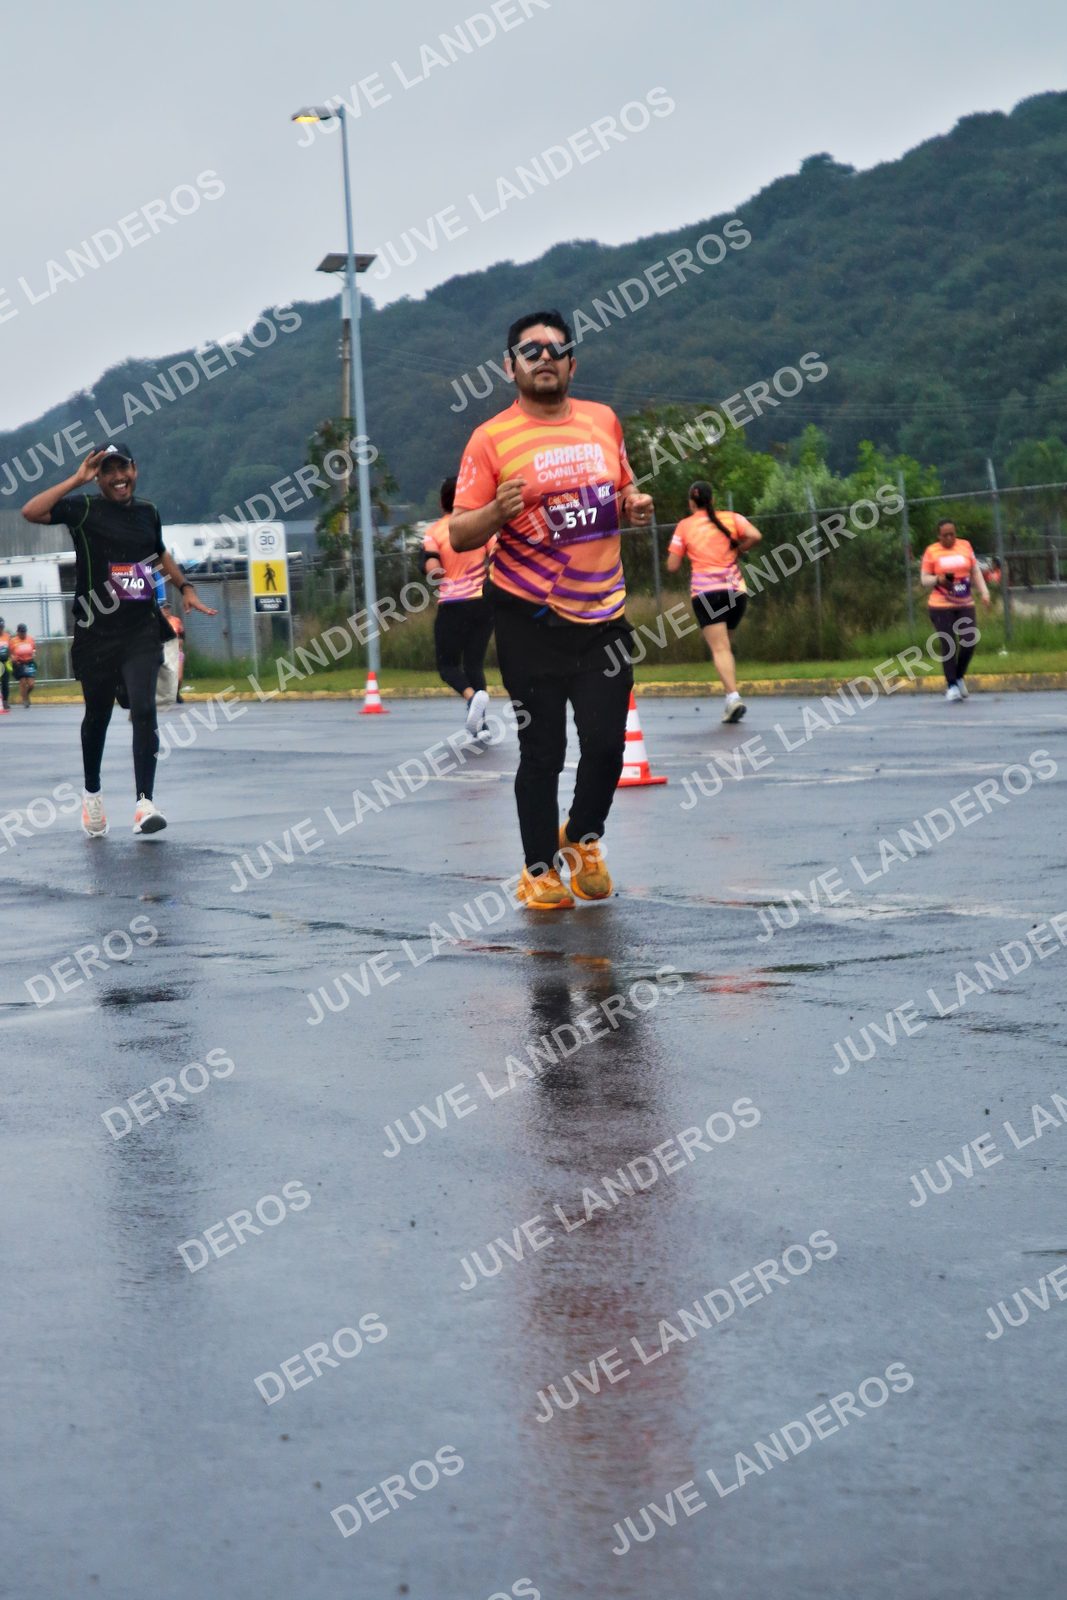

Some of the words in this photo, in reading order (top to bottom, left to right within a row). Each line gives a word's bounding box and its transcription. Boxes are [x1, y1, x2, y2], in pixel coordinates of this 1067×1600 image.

[534, 443, 605, 471] CARRERA
[537, 463, 593, 483] OMNILIFE
[565, 507, 597, 528] 517
[260, 536, 275, 545] 30
[122, 578, 145, 589] 740
